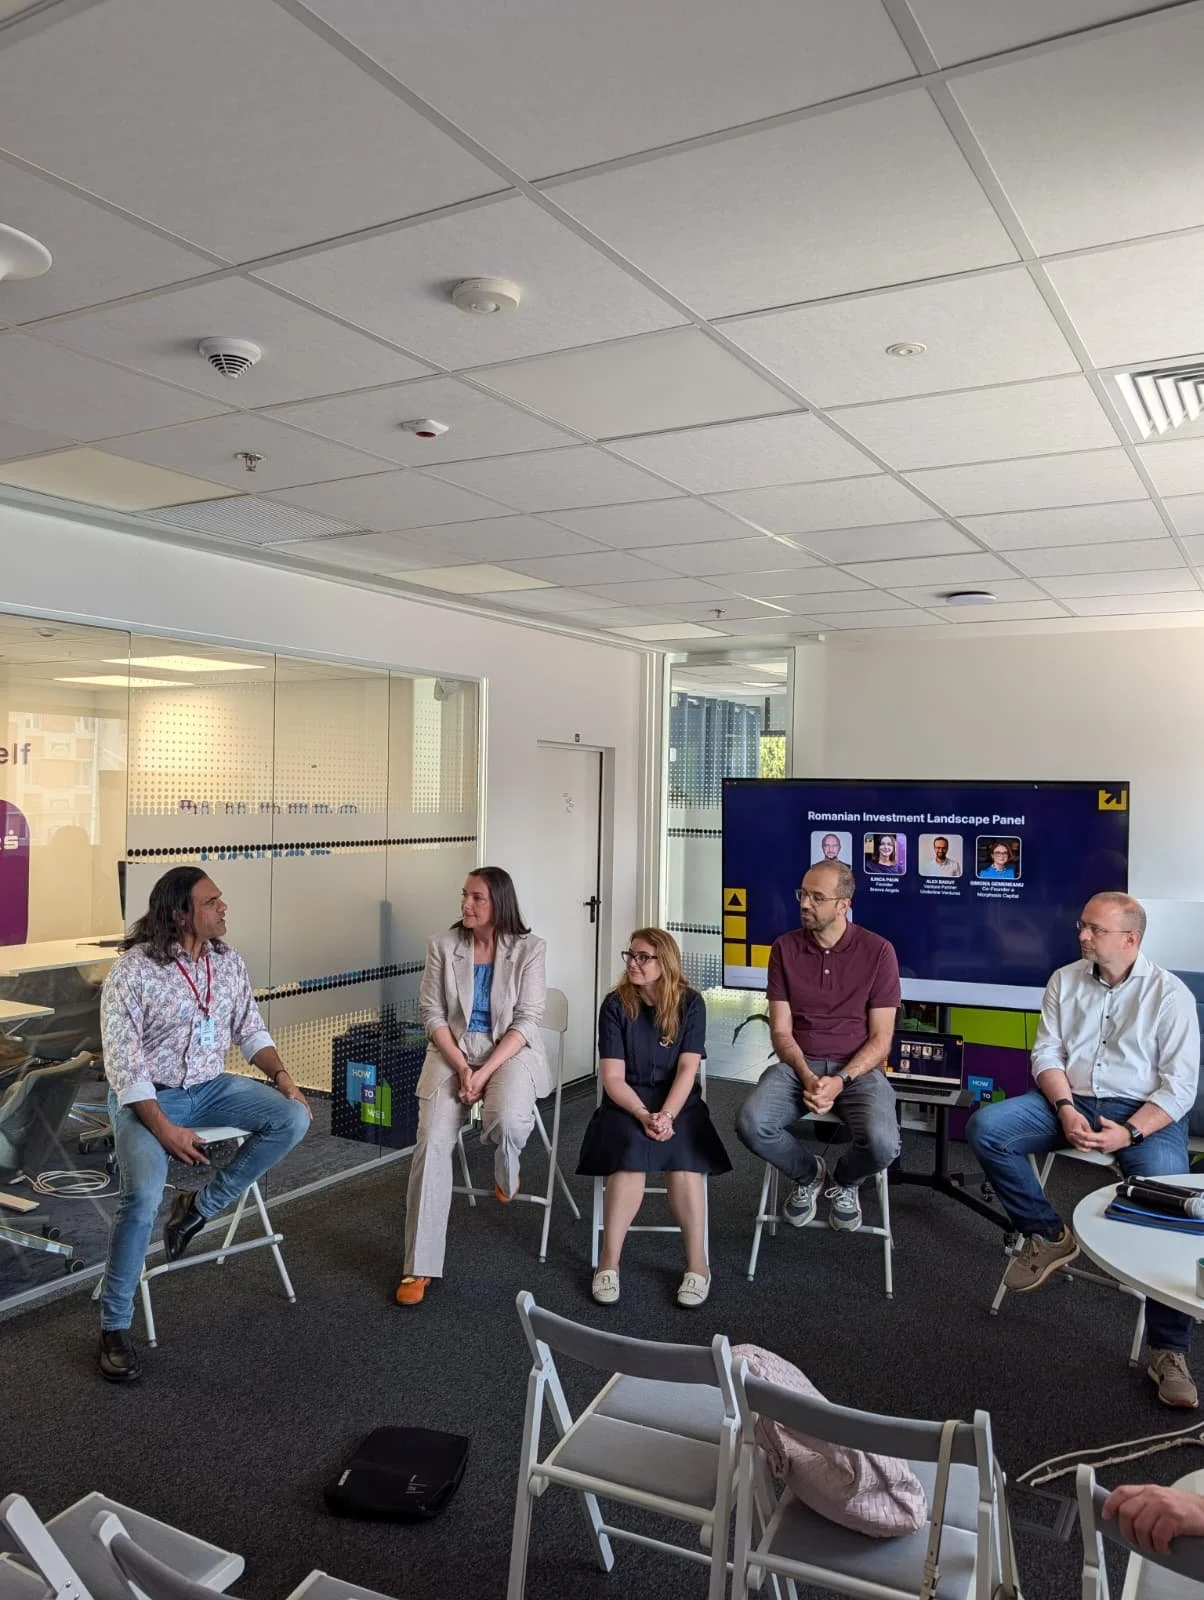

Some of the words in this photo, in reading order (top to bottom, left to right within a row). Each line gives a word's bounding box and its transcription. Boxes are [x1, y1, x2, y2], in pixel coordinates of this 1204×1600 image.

[808, 811, 861, 822] Romanian
[862, 812, 925, 823] Investment
[927, 813, 989, 826] Landscape
[992, 814, 1025, 825] Panel
[352, 1068, 371, 1079] HOW
[972, 1079, 989, 1087] HOW
[364, 1089, 373, 1098] TO
